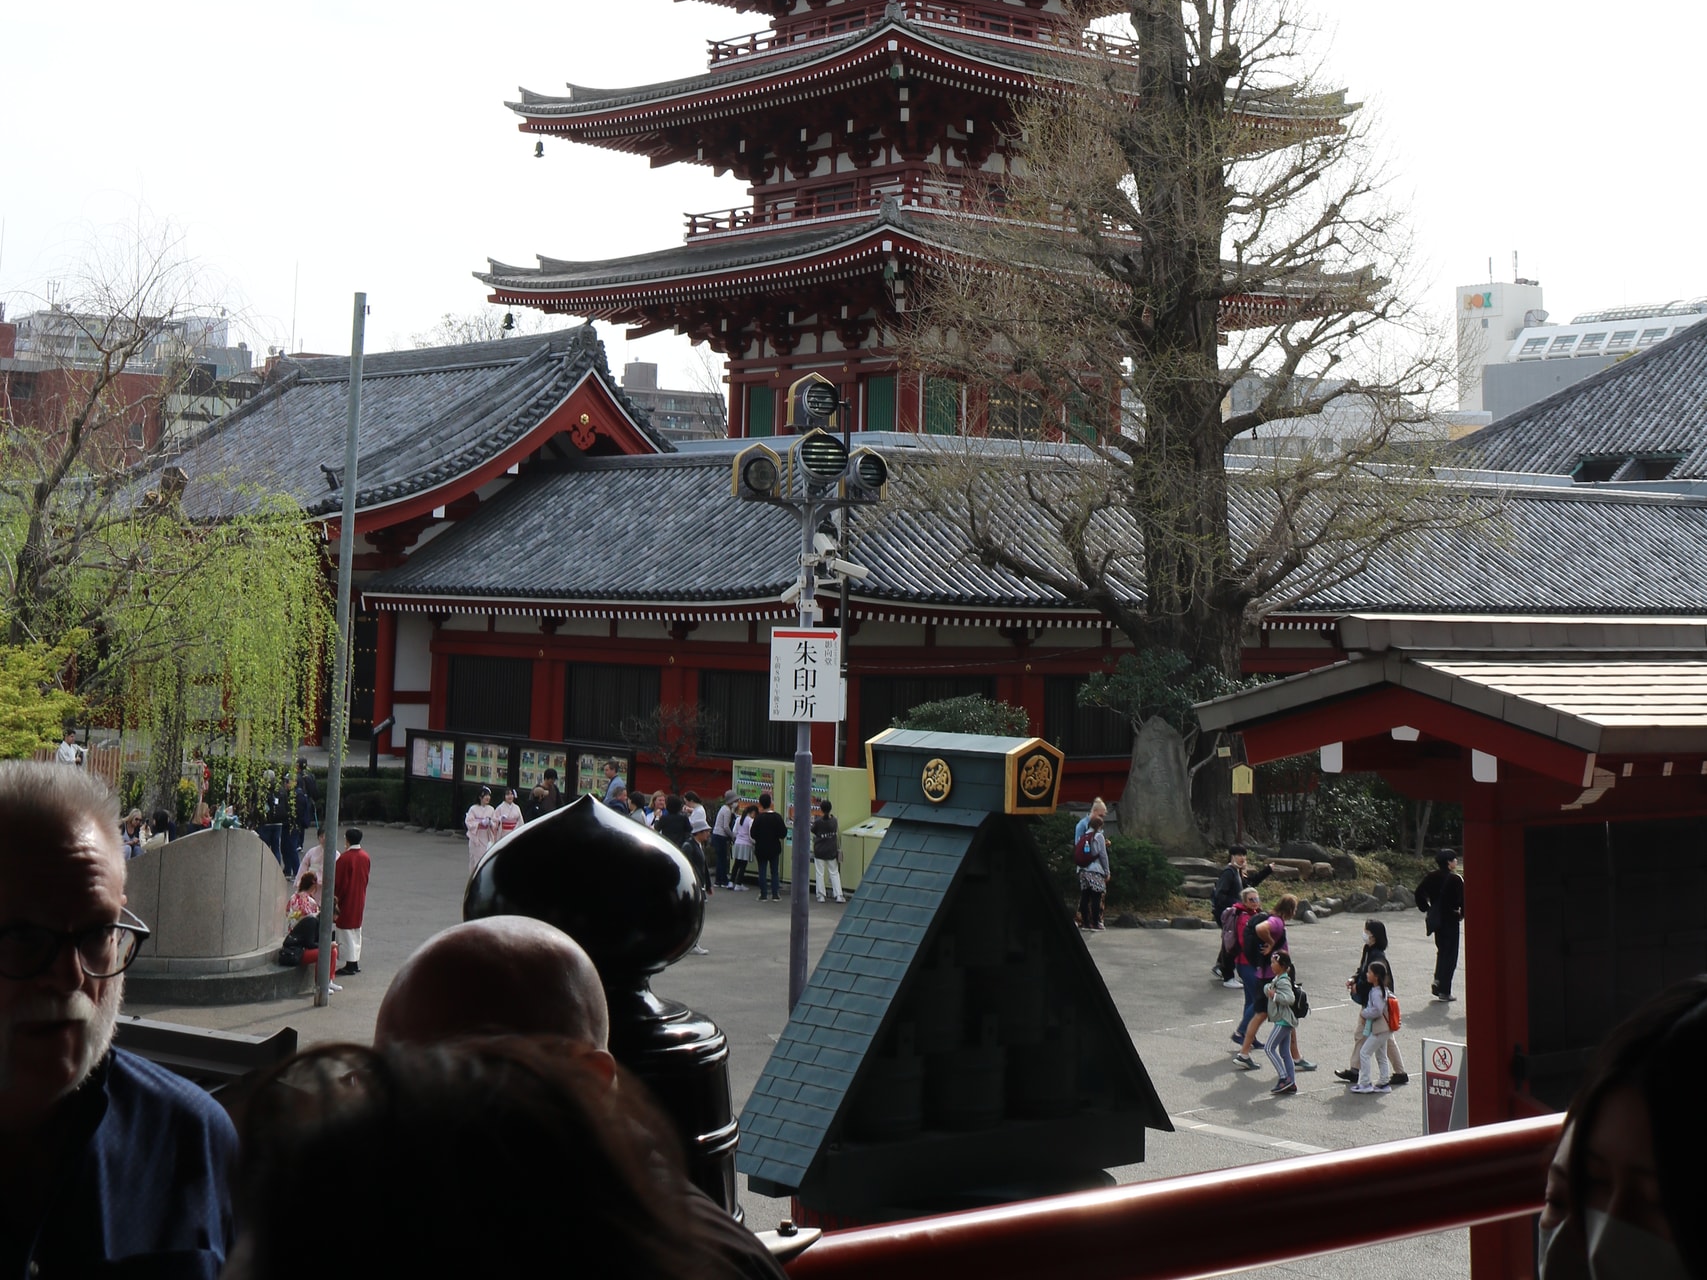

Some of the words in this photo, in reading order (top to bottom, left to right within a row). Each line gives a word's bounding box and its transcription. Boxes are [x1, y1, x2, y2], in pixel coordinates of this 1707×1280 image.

[792, 640, 817, 718] 朱印所
[1432, 1078, 1450, 1088] 自転車
